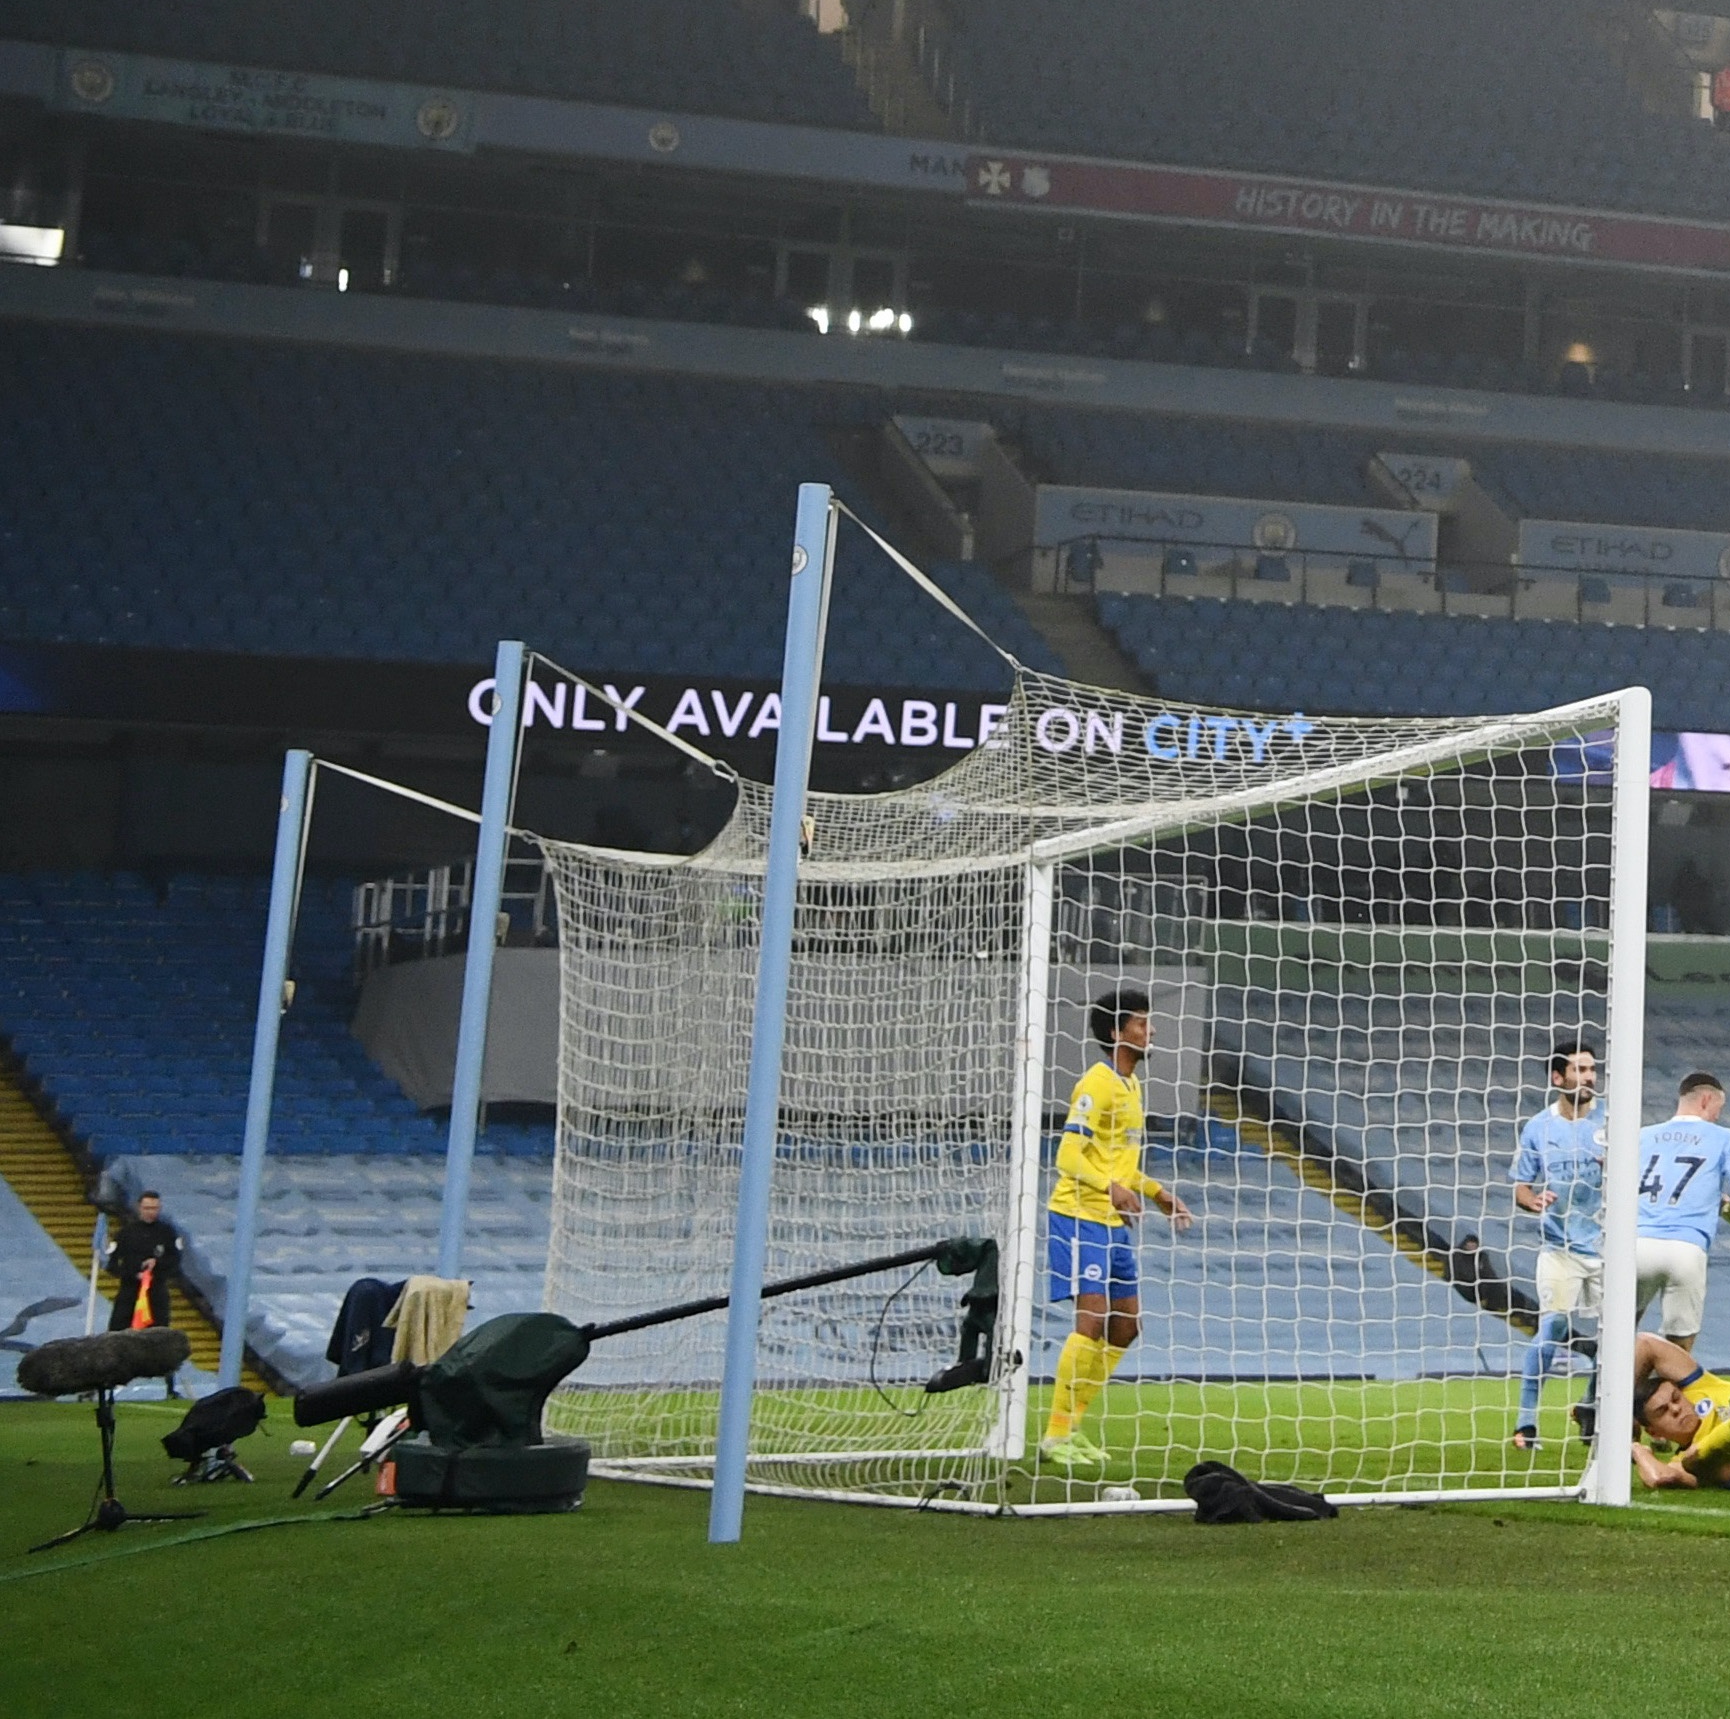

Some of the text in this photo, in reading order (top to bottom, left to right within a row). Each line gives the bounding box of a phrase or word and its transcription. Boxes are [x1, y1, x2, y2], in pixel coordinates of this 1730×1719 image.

[1235, 185, 1595, 252] HISTORY IN THE MAKING
[917, 430, 964, 456] 223
[1398, 467, 1442, 492] 224
[1069, 501, 1204, 529] ETIHAD
[1550, 534, 1675, 561] ETIHAD
[665, 687, 1010, 750] AVALABLE
[1035, 707, 1123, 755] ON
[1654, 1131, 1703, 1146] FODEN
[1638, 1154, 1707, 1205] 47
